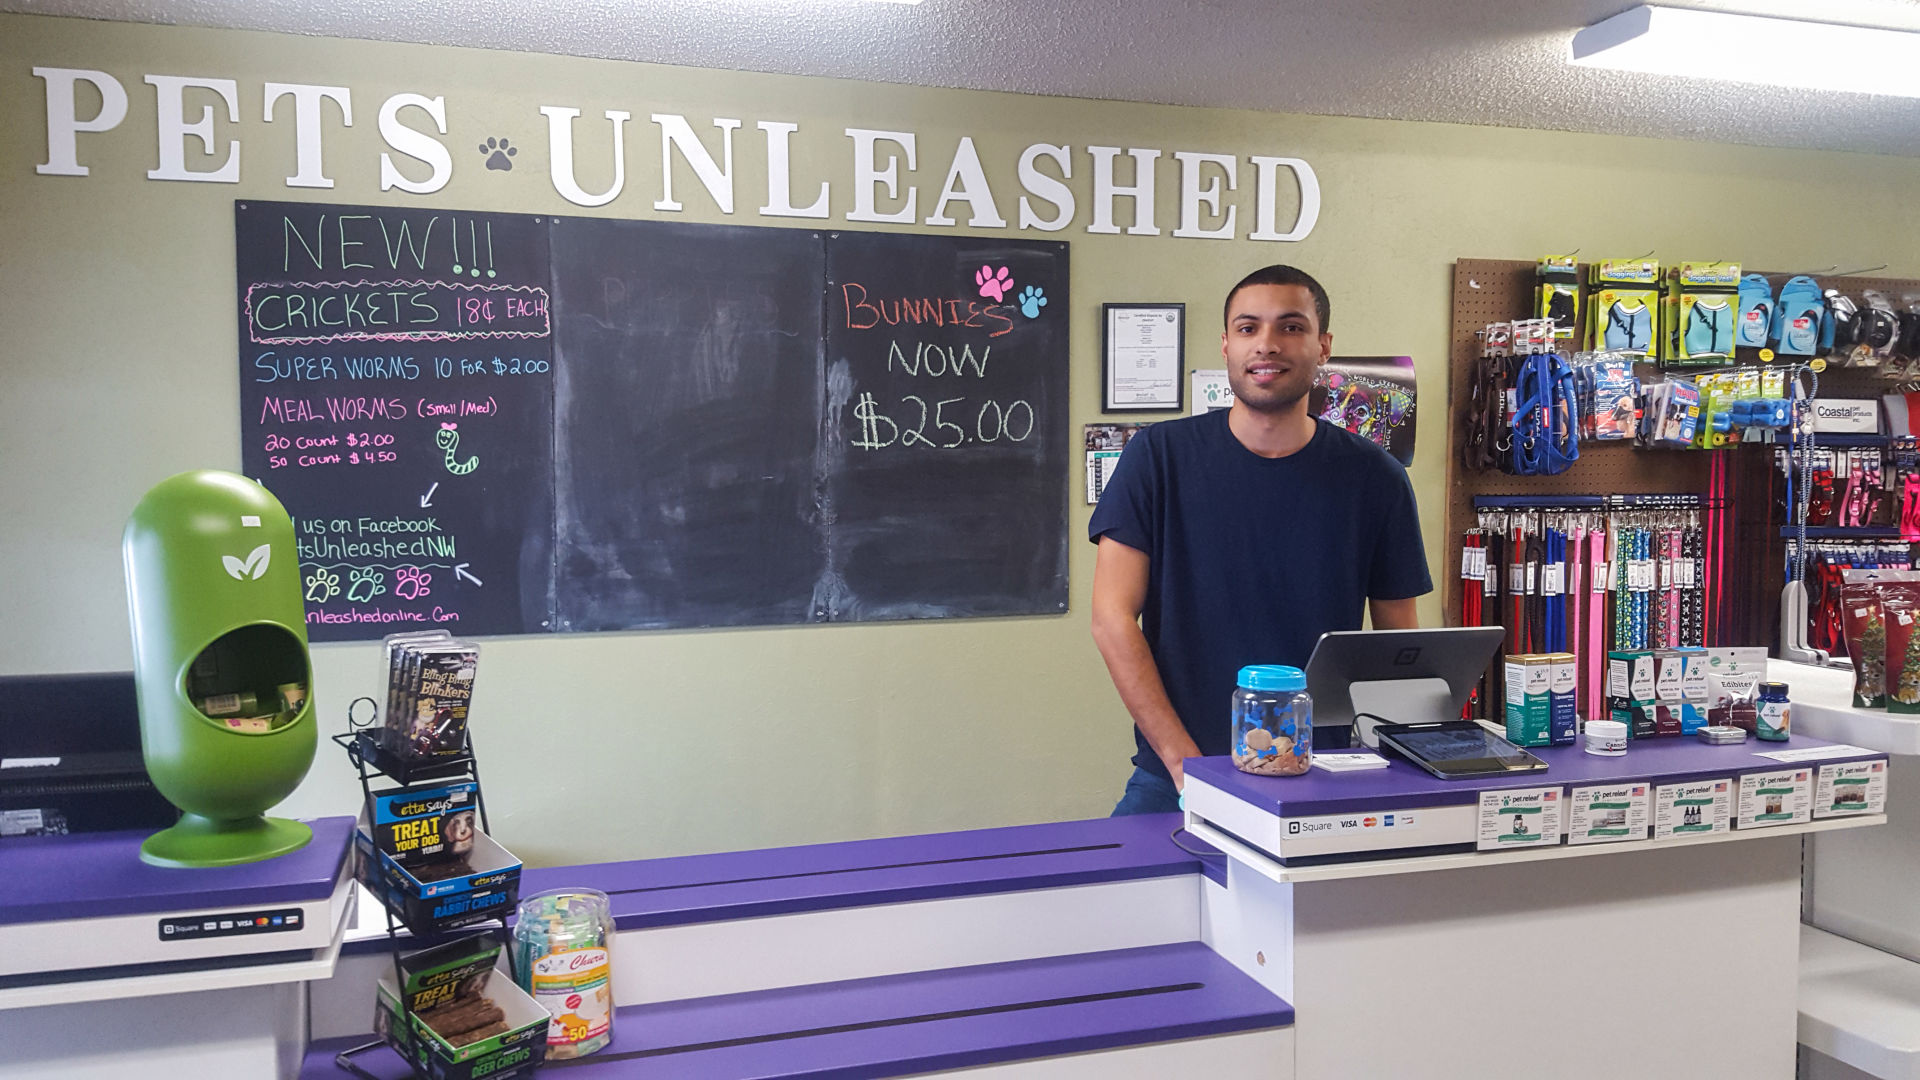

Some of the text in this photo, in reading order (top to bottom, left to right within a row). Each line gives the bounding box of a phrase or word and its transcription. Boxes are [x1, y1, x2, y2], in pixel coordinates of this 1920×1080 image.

[32, 66, 1321, 243] PETS UNLEASHED
[284, 214, 497, 278] NEW!!!
[255, 291, 545, 331] CRICKETS 18¢ EACH
[842, 282, 1014, 338] BUNNIES
[343, 356, 420, 380] WORMS
[434, 356, 453, 379] 10
[492, 358, 550, 377] $2.00
[888, 340, 991, 378] NOW
[260, 396, 325, 426] MEAL
[326, 396, 407, 420] WORMS
[850, 391, 1034, 451] $25.00
[1818, 405, 1853, 418] Coastal
[265, 434, 290, 451] 20
[347, 432, 395, 448] $2.00
[269, 455, 288, 469] 50
[303, 516, 443, 537] us on Facebook
[421, 668, 449, 686] Bling
[420, 681, 471, 699] Blinkers
[1523, 794, 1540, 802] releaf
[1602, 789, 1628, 799] pet releaf
[1686, 788, 1695, 796] pet
[401, 799, 453, 816] etta says
[391, 816, 441, 842] TREAT
[1302, 822, 1333, 832] Square
[1340, 820, 1358, 828] VISA
[395, 834, 440, 852] YOUR DOG
[433, 899, 471, 919] RABBIT
[471, 891, 507, 910] CHEWS
[236, 919, 254, 928] VISA
[415, 980, 460, 1006] TREAT
[568, 1025, 588, 1042] 50
[472, 1060, 496, 1080] DEER
[496, 1047, 531, 1070] CHEWS
